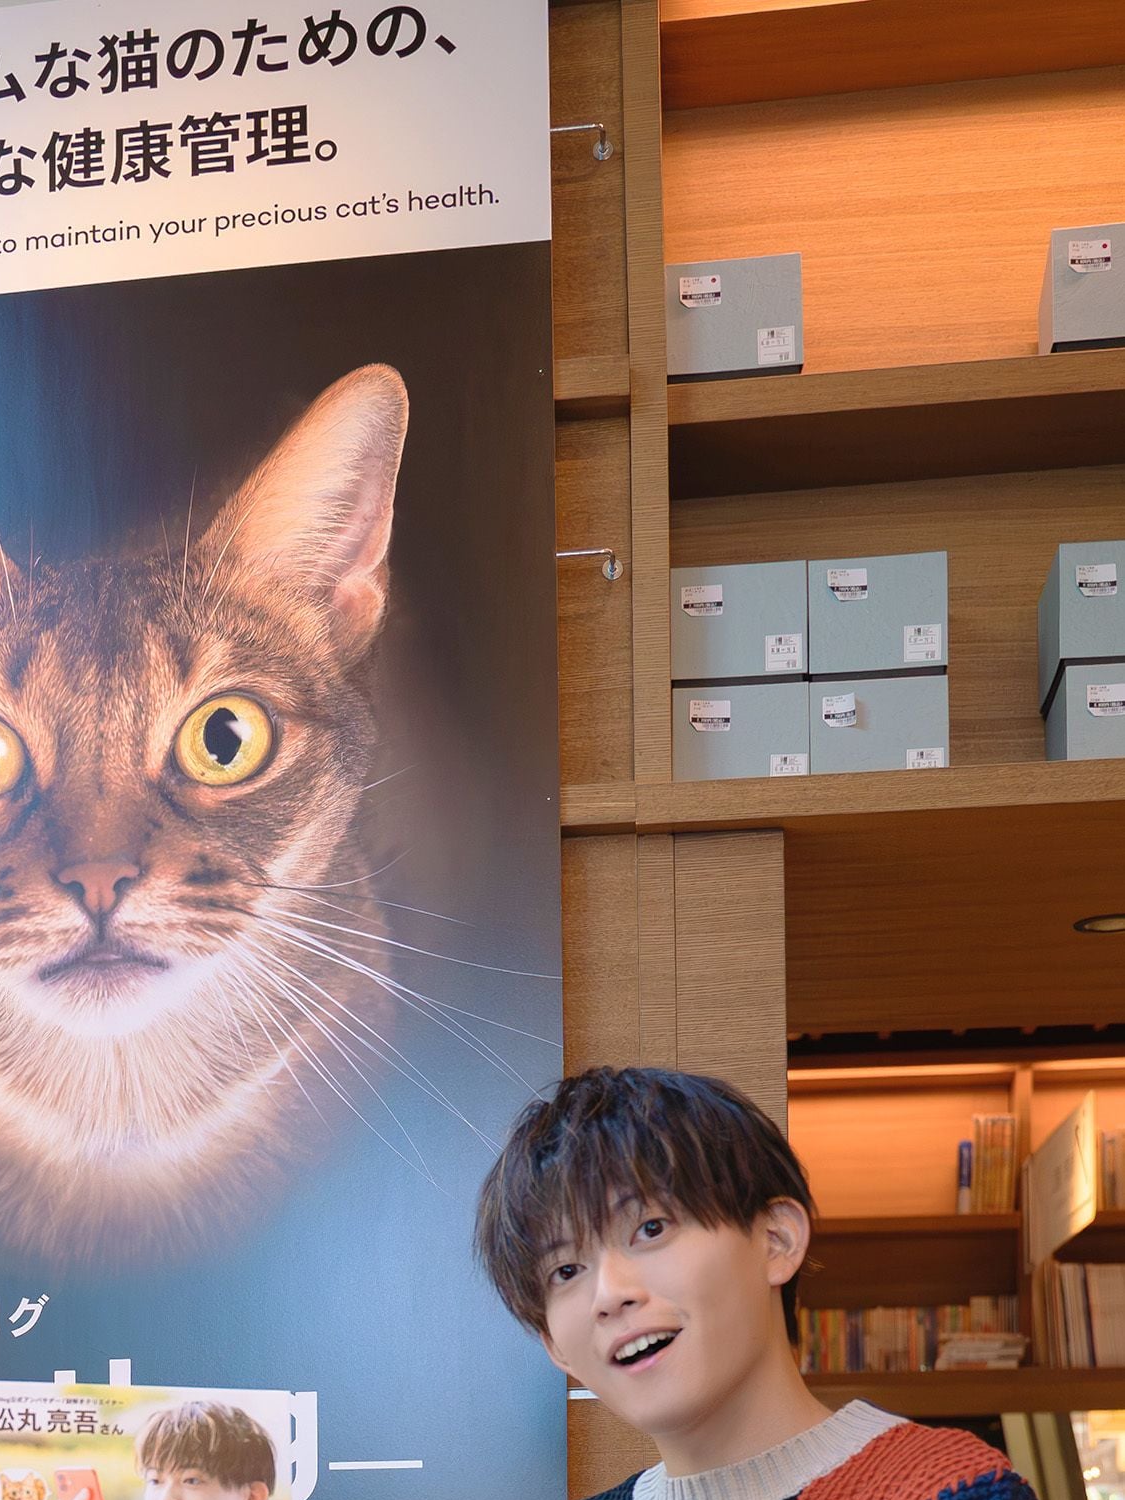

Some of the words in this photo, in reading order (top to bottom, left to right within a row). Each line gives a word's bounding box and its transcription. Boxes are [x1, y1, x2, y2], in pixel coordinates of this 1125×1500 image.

[24, 218, 142, 252] maintain
[148, 216, 208, 248] your
[214, 202, 329, 238] precious
[335, 191, 400, 221] cat's
[407, 183, 501, 213] health.
